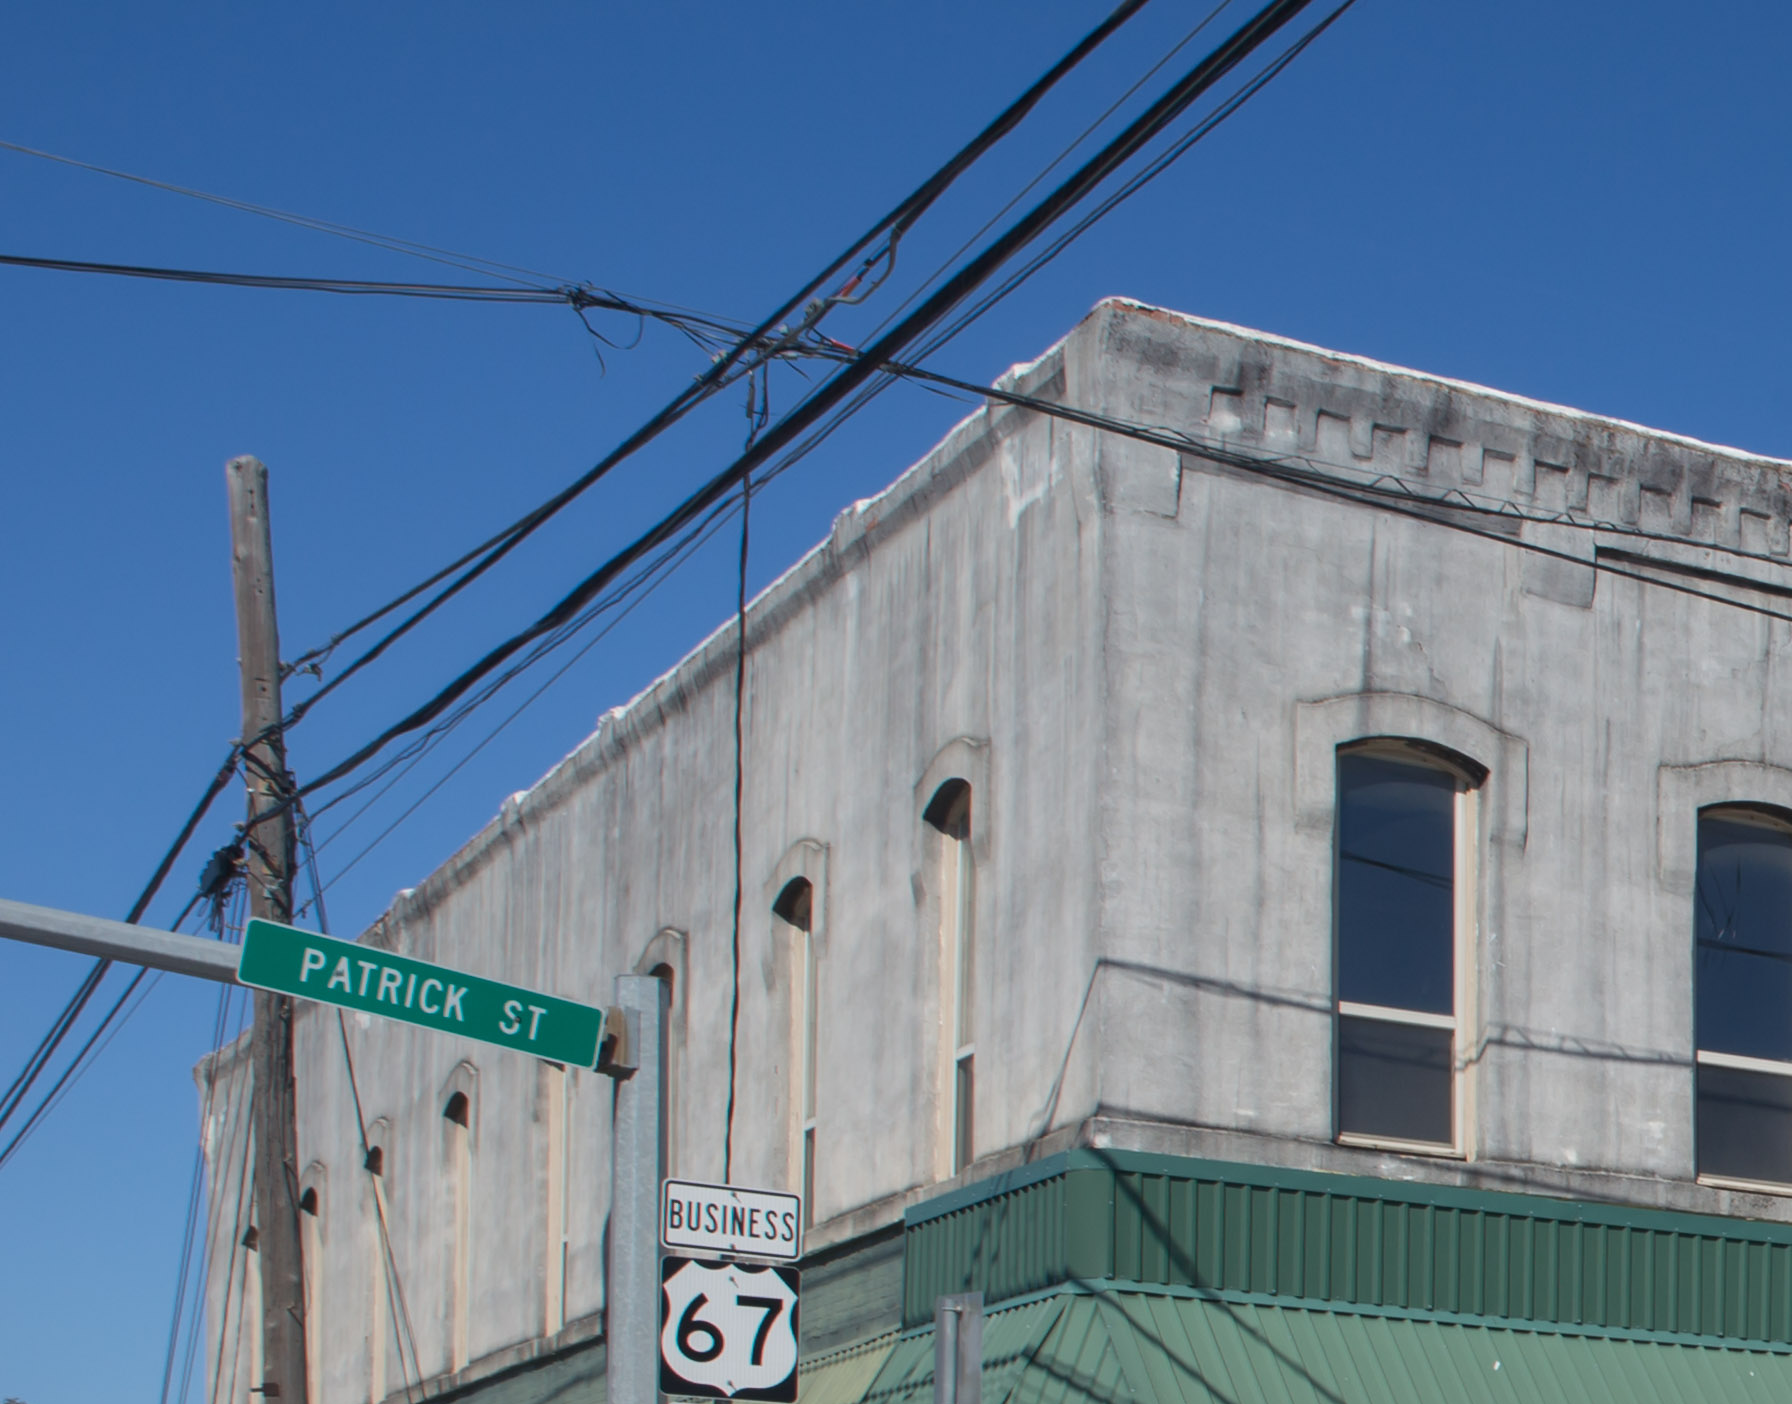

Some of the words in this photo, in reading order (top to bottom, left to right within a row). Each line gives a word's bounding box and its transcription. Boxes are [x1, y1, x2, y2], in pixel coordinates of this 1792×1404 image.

[299, 947, 469, 1022] PATRICK
[499, 1000, 548, 1041] ST
[669, 1198, 794, 1242] BUSINESS
[676, 1292, 784, 1366] 67
